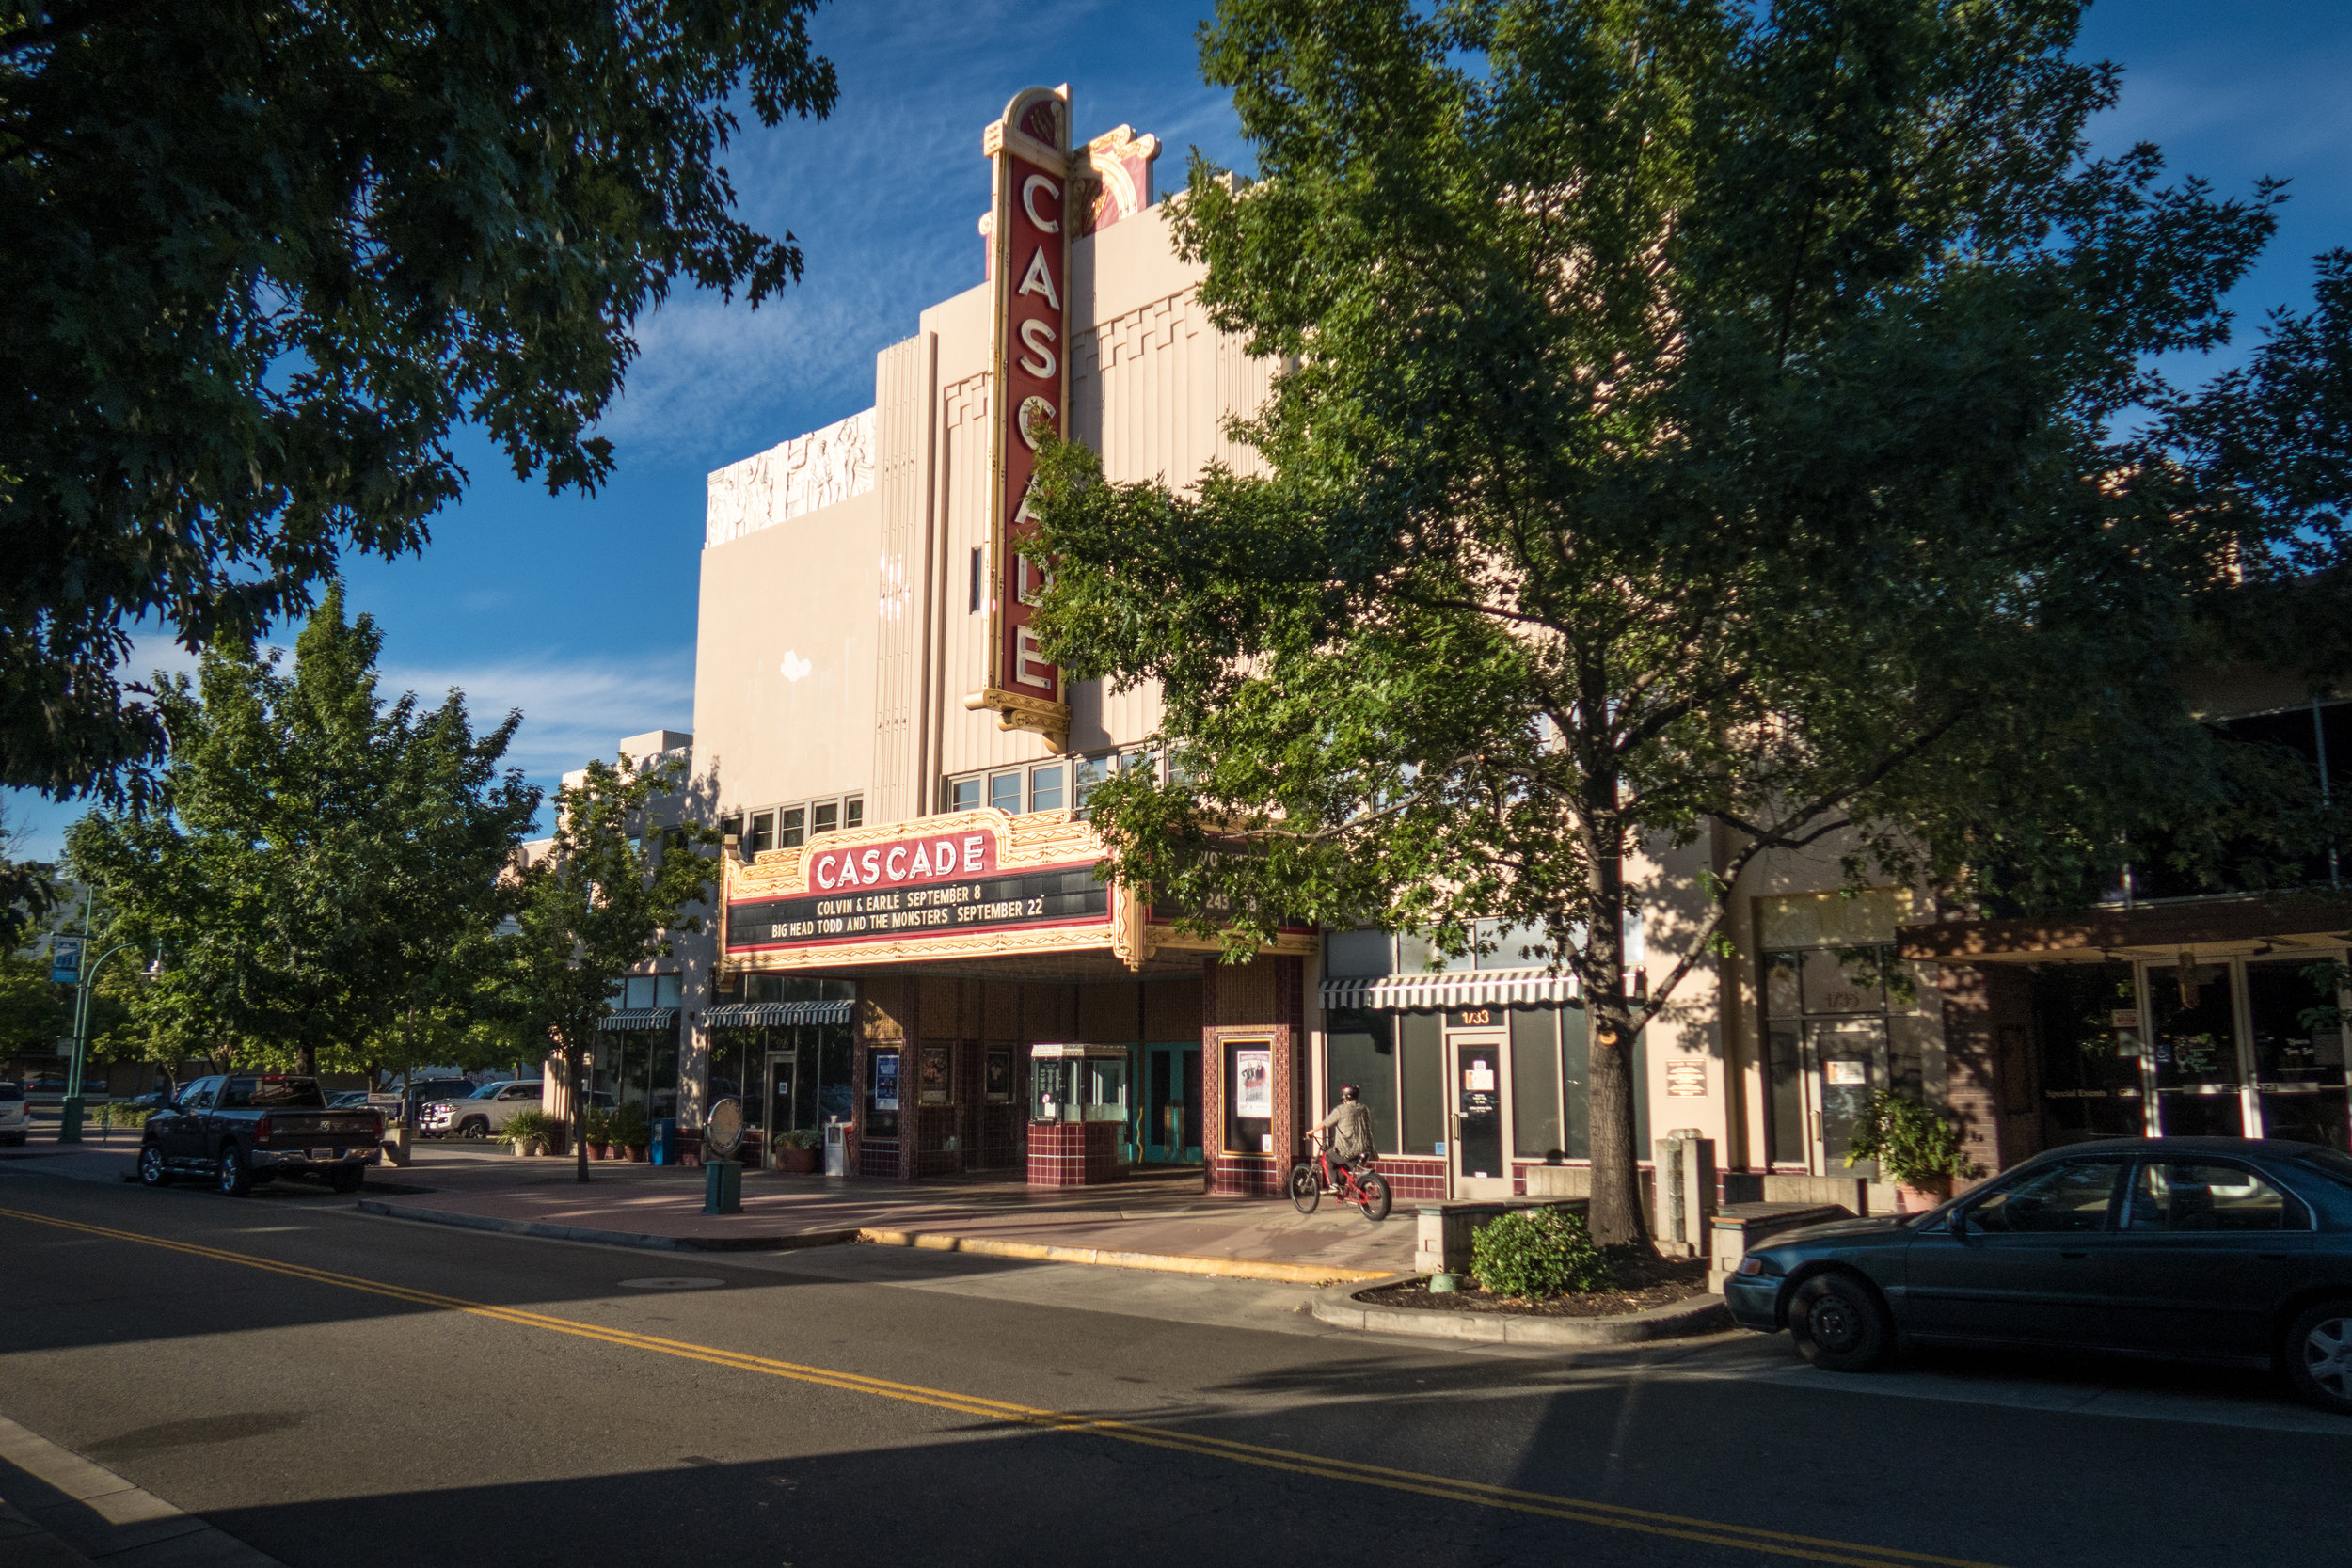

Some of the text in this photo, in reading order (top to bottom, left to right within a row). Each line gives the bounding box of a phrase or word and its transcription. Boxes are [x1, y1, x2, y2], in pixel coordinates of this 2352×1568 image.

[817, 835, 985, 889] CASCADE
[817, 884, 981, 916] COLVIN & EARLE SEPTEMBER 8
[771, 898, 1043, 939] BIG HEAD TODD AND THE MONSTERS SEPTEMBER 22
[1462, 1009, 1490, 1024] 1733
